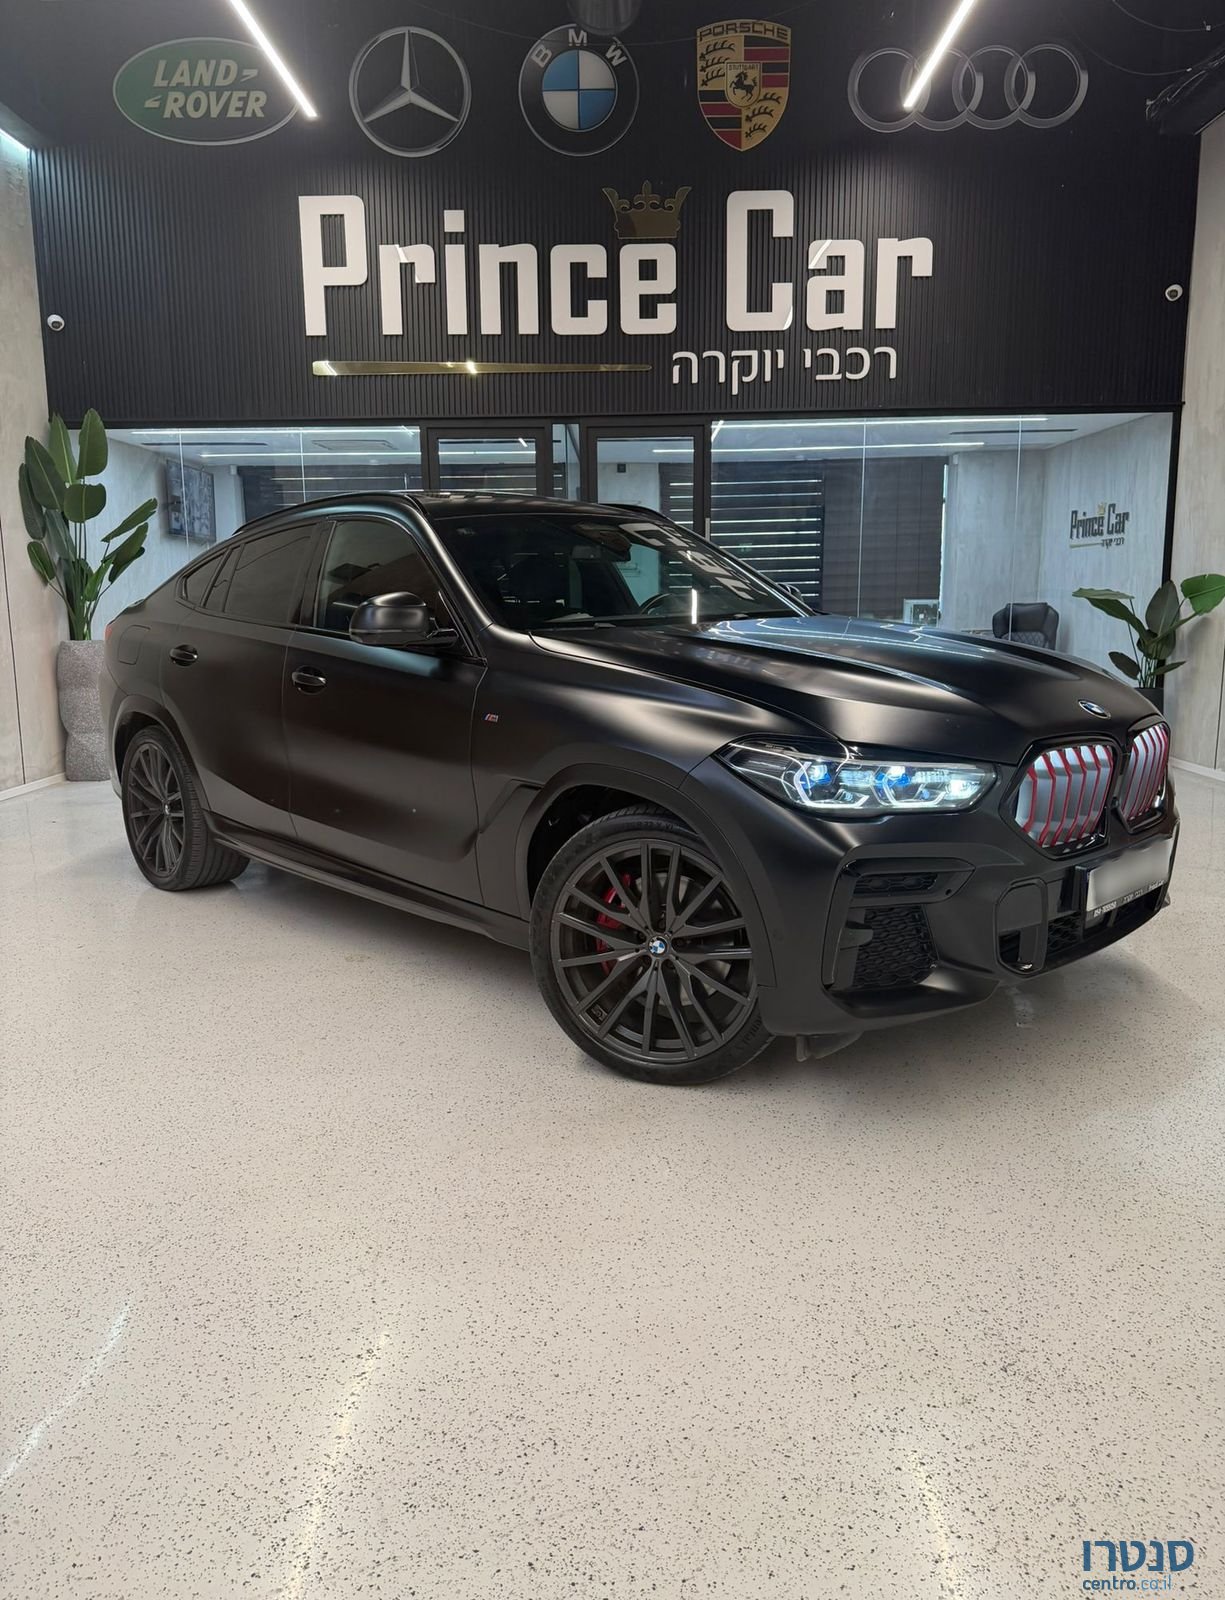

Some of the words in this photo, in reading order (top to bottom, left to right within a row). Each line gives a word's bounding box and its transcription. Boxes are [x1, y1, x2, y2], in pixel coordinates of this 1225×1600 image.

[530, 28, 628, 68] BMW
[699, 22, 788, 41] PORSCHE
[153, 59, 239, 87] LAND
[162, 90, 268, 119] ROVER
[299, 195, 677, 336] Prince
[726, 190, 933, 331] Car
[672, 349, 785, 396] יוקרה
[803, 346, 897, 381] רכבי
[1070, 510, 1105, 540] Prince
[1106, 503, 1130, 535] Car
